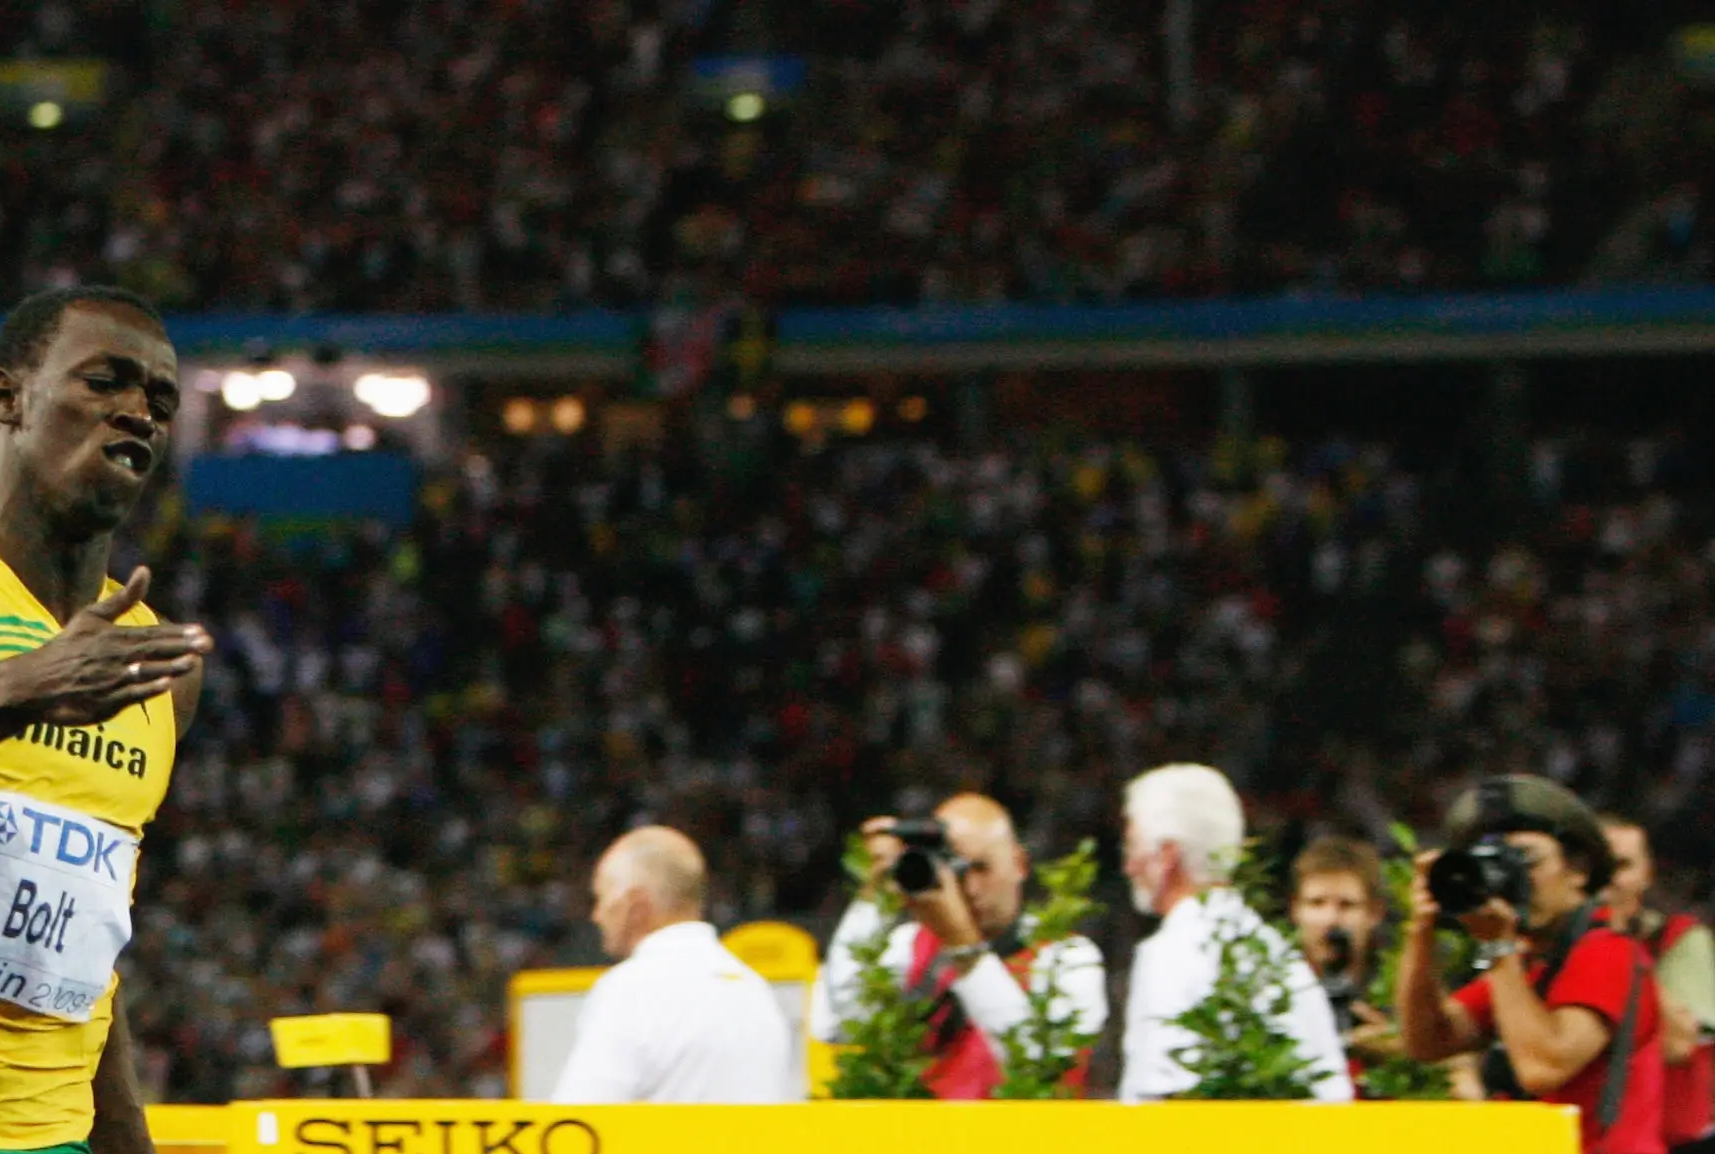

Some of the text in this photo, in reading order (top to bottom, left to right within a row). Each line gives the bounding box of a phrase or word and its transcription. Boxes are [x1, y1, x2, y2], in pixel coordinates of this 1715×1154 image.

[13, 720, 148, 780] maica
[22, 806, 123, 882] TDK
[2, 878, 75, 954] Bolt
